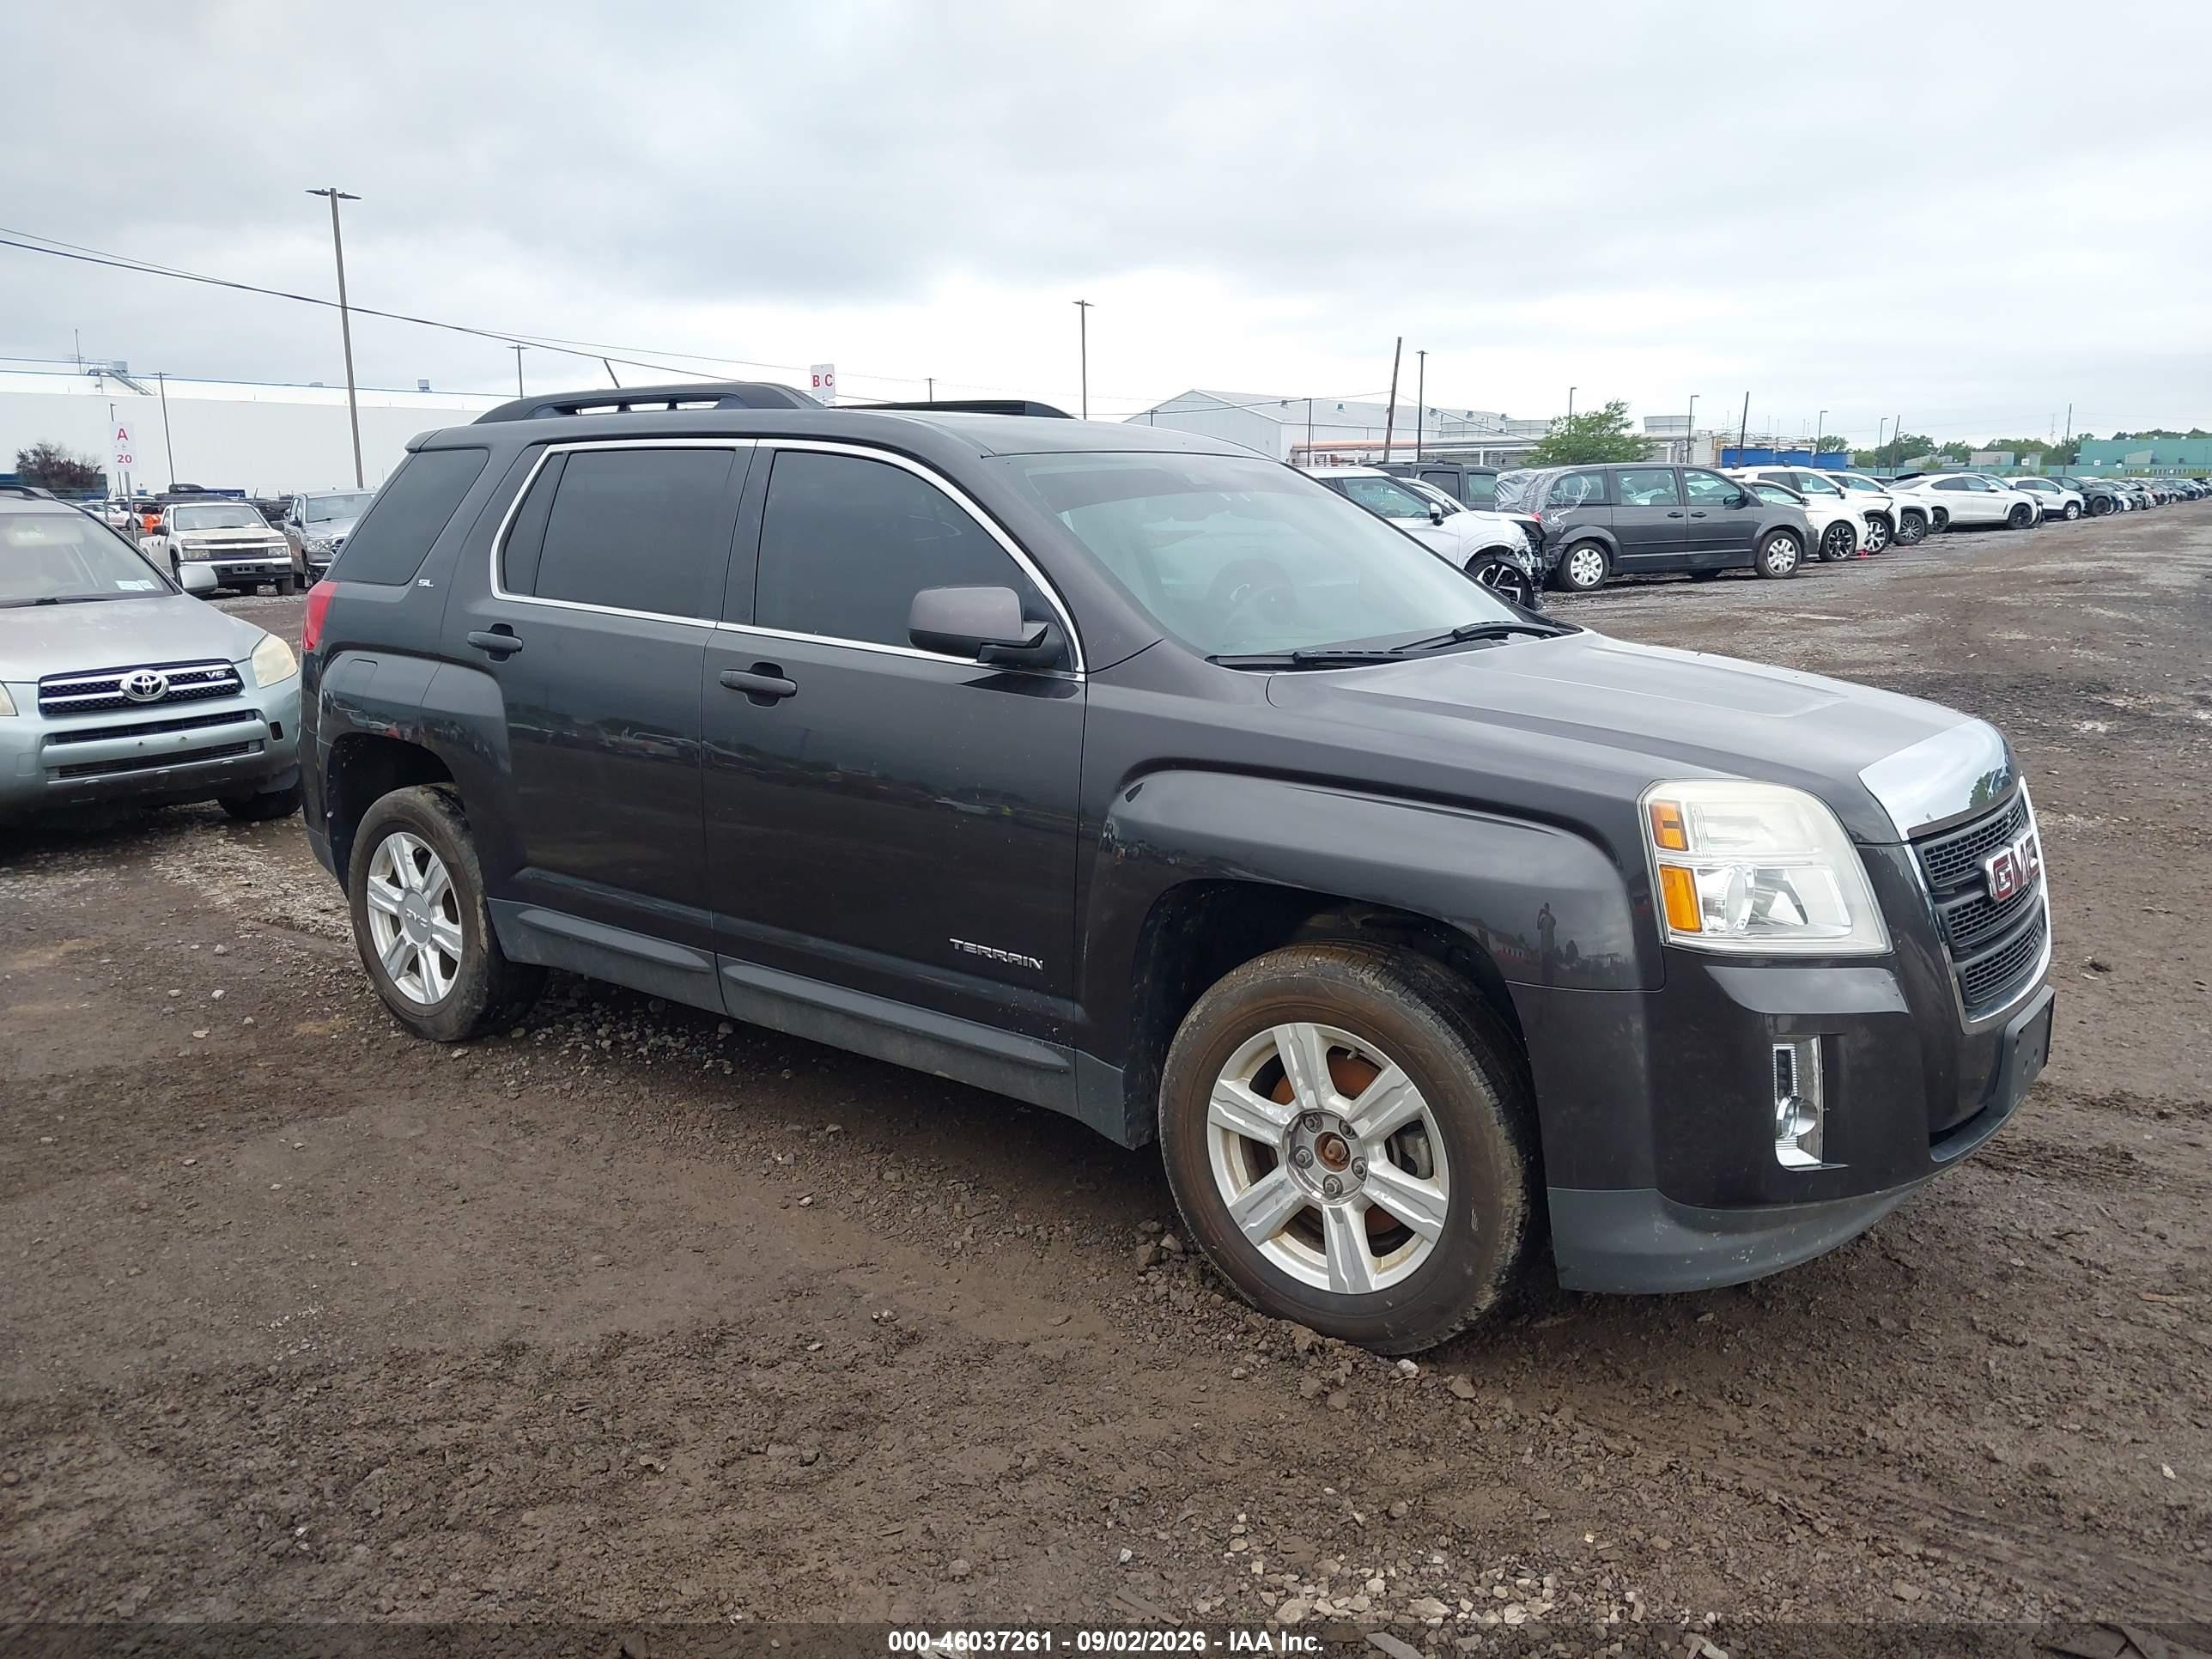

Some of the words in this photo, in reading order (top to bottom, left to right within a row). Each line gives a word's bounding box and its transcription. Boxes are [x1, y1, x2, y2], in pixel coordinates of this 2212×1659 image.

[812, 374, 821, 388] B
[824, 374, 834, 387] C
[117, 428, 129, 441] A
[117, 454, 132, 464] 20
[417, 579, 434, 587] SL
[205, 670, 227, 680] V6
[949, 938, 1044, 971] TERRAIN
